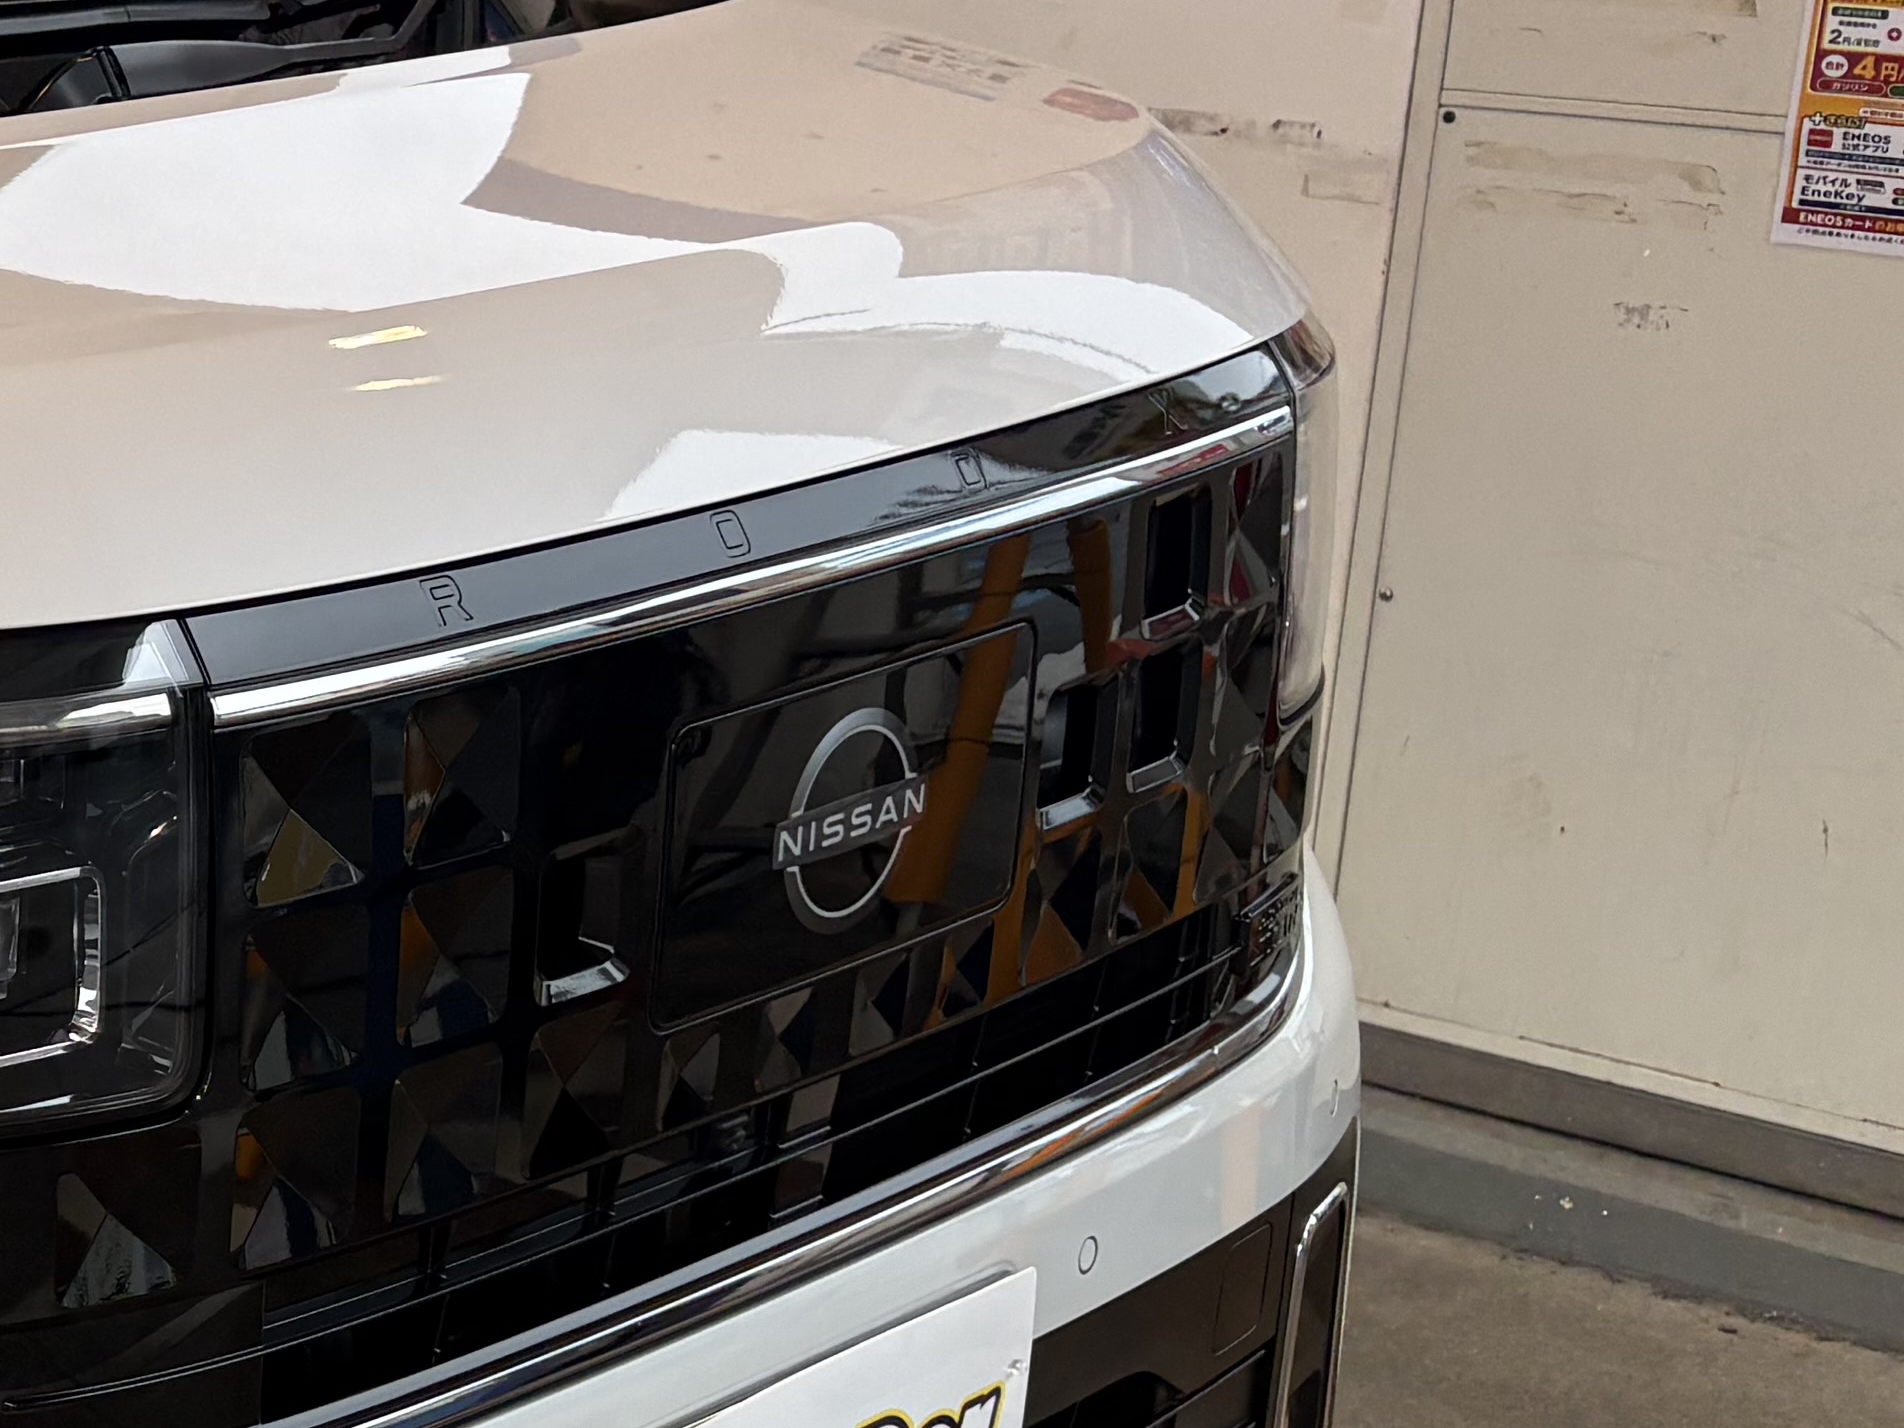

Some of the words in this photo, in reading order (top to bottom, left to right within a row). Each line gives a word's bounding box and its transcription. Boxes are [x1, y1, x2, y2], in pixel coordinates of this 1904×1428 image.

[1843, 131, 1891, 145] ENEOS
[1803, 174, 1851, 189] モバイル
[1801, 186, 1866, 204] EneKey
[777, 781, 927, 860] NISSAN
